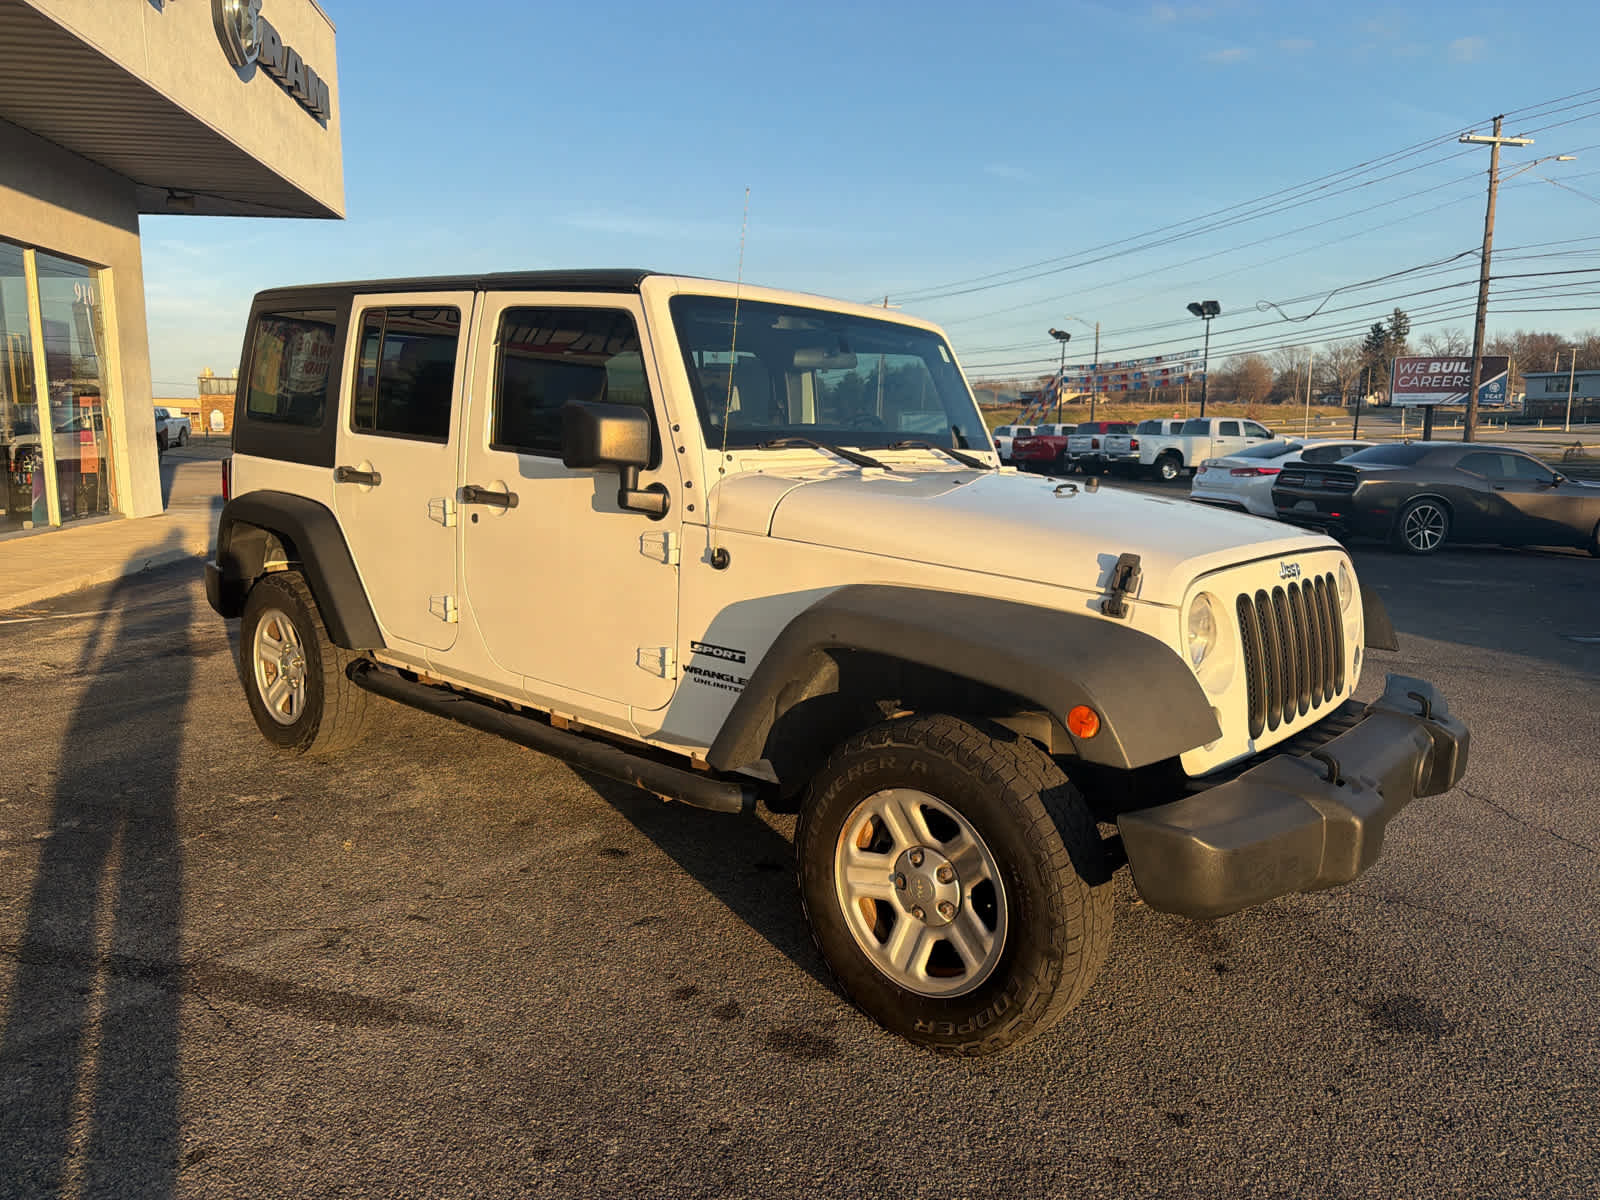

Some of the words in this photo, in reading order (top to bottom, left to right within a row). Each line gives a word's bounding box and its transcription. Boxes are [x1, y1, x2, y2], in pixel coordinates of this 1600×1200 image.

[257, 15, 331, 121] RAM
[74, 282, 95, 305] 910
[1399, 362, 1426, 374] WE
[1428, 361, 1483, 373] BUIL
[1398, 375, 1471, 388] CAREERS
[690, 640, 746, 663] SPORT
[682, 664, 748, 685] WRANGLE
